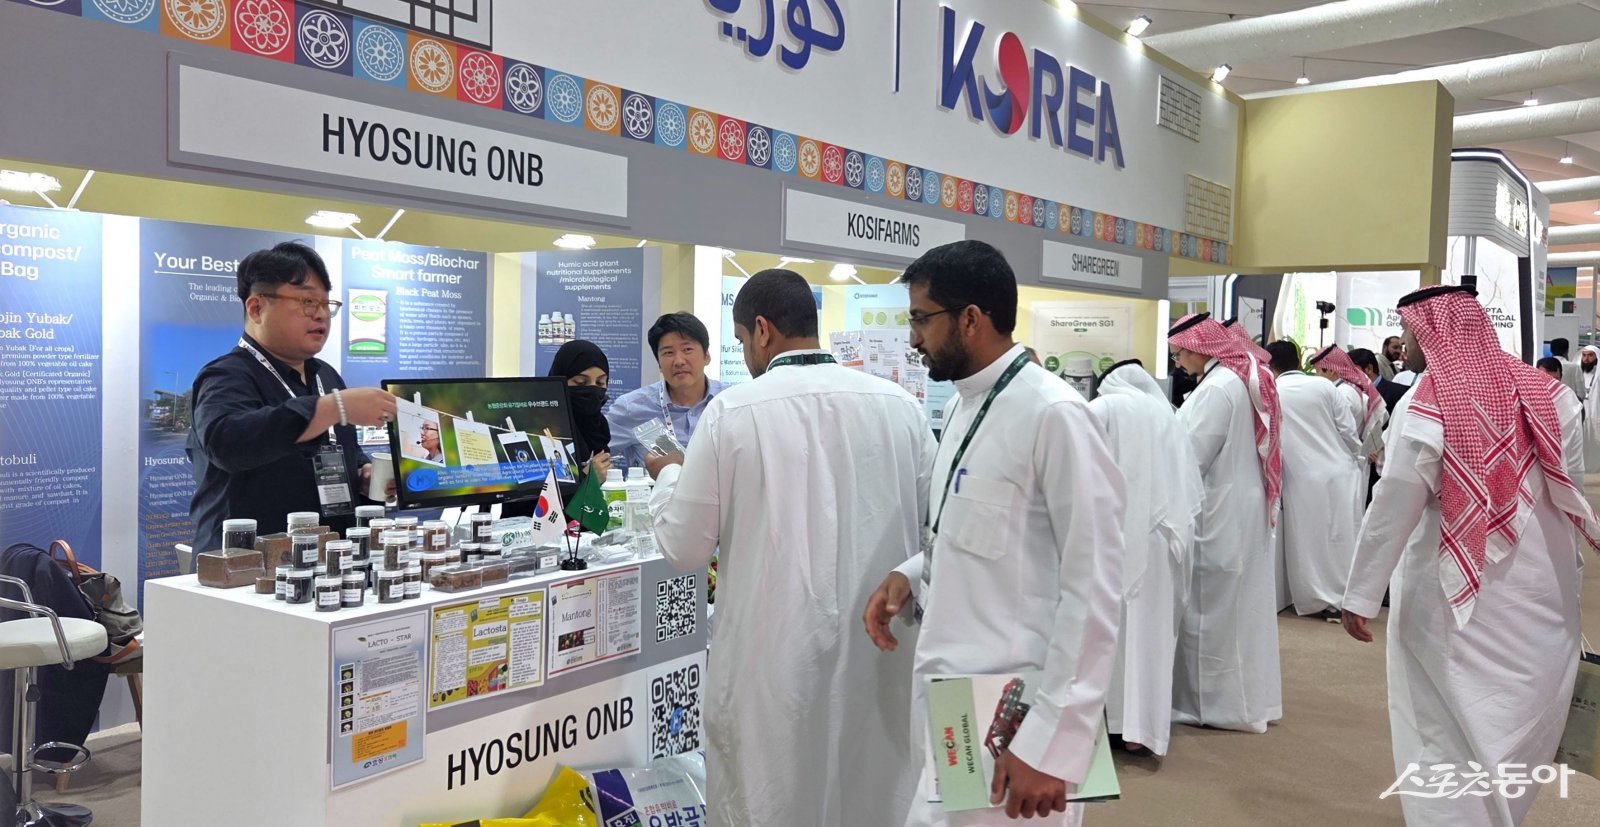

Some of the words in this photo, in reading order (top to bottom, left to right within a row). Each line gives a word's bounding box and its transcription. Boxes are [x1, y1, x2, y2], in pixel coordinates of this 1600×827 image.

[941, 5, 1126, 169] KOREA
[322, 113, 476, 177] HYOSUNG
[487, 145, 544, 187] ONB
[848, 212, 920, 248] KOSIFARMS
[0, 244, 81, 261] ompost/
[1, 261, 39, 280] Bag
[154, 253, 198, 270] Your
[201, 255, 241, 273] Best
[600, 260, 619, 268] plant
[1071, 252, 1119, 277] SHAREGREEN
[416, 268, 462, 284] farmer
[546, 268, 582, 276] nutritional
[584, 268, 632, 276] supplements
[188, 282, 204, 291] The
[206, 283, 232, 293] leading
[559, 276, 618, 284] /microbiological
[190, 293, 219, 303] Organic
[421, 290, 440, 298] Peat
[441, 290, 462, 300] Moss
[722, 293, 734, 306] MS
[26, 312, 73, 325] Yubak/
[25, 328, 55, 340] Gold
[144, 456, 184, 466] Hyosung
[562, 609, 592, 622] Mantong
[473, 624, 507, 638] Lactosta
[368, 638, 389, 648] LACTO
[396, 633, 412, 643] STAR
[960, 712, 972, 743] GLOBAL
[447, 714, 578, 790] HYOSUNG
[586, 696, 634, 740] ONB
[944, 726, 958, 767] WECAN
[964, 744, 976, 774] WECAN
